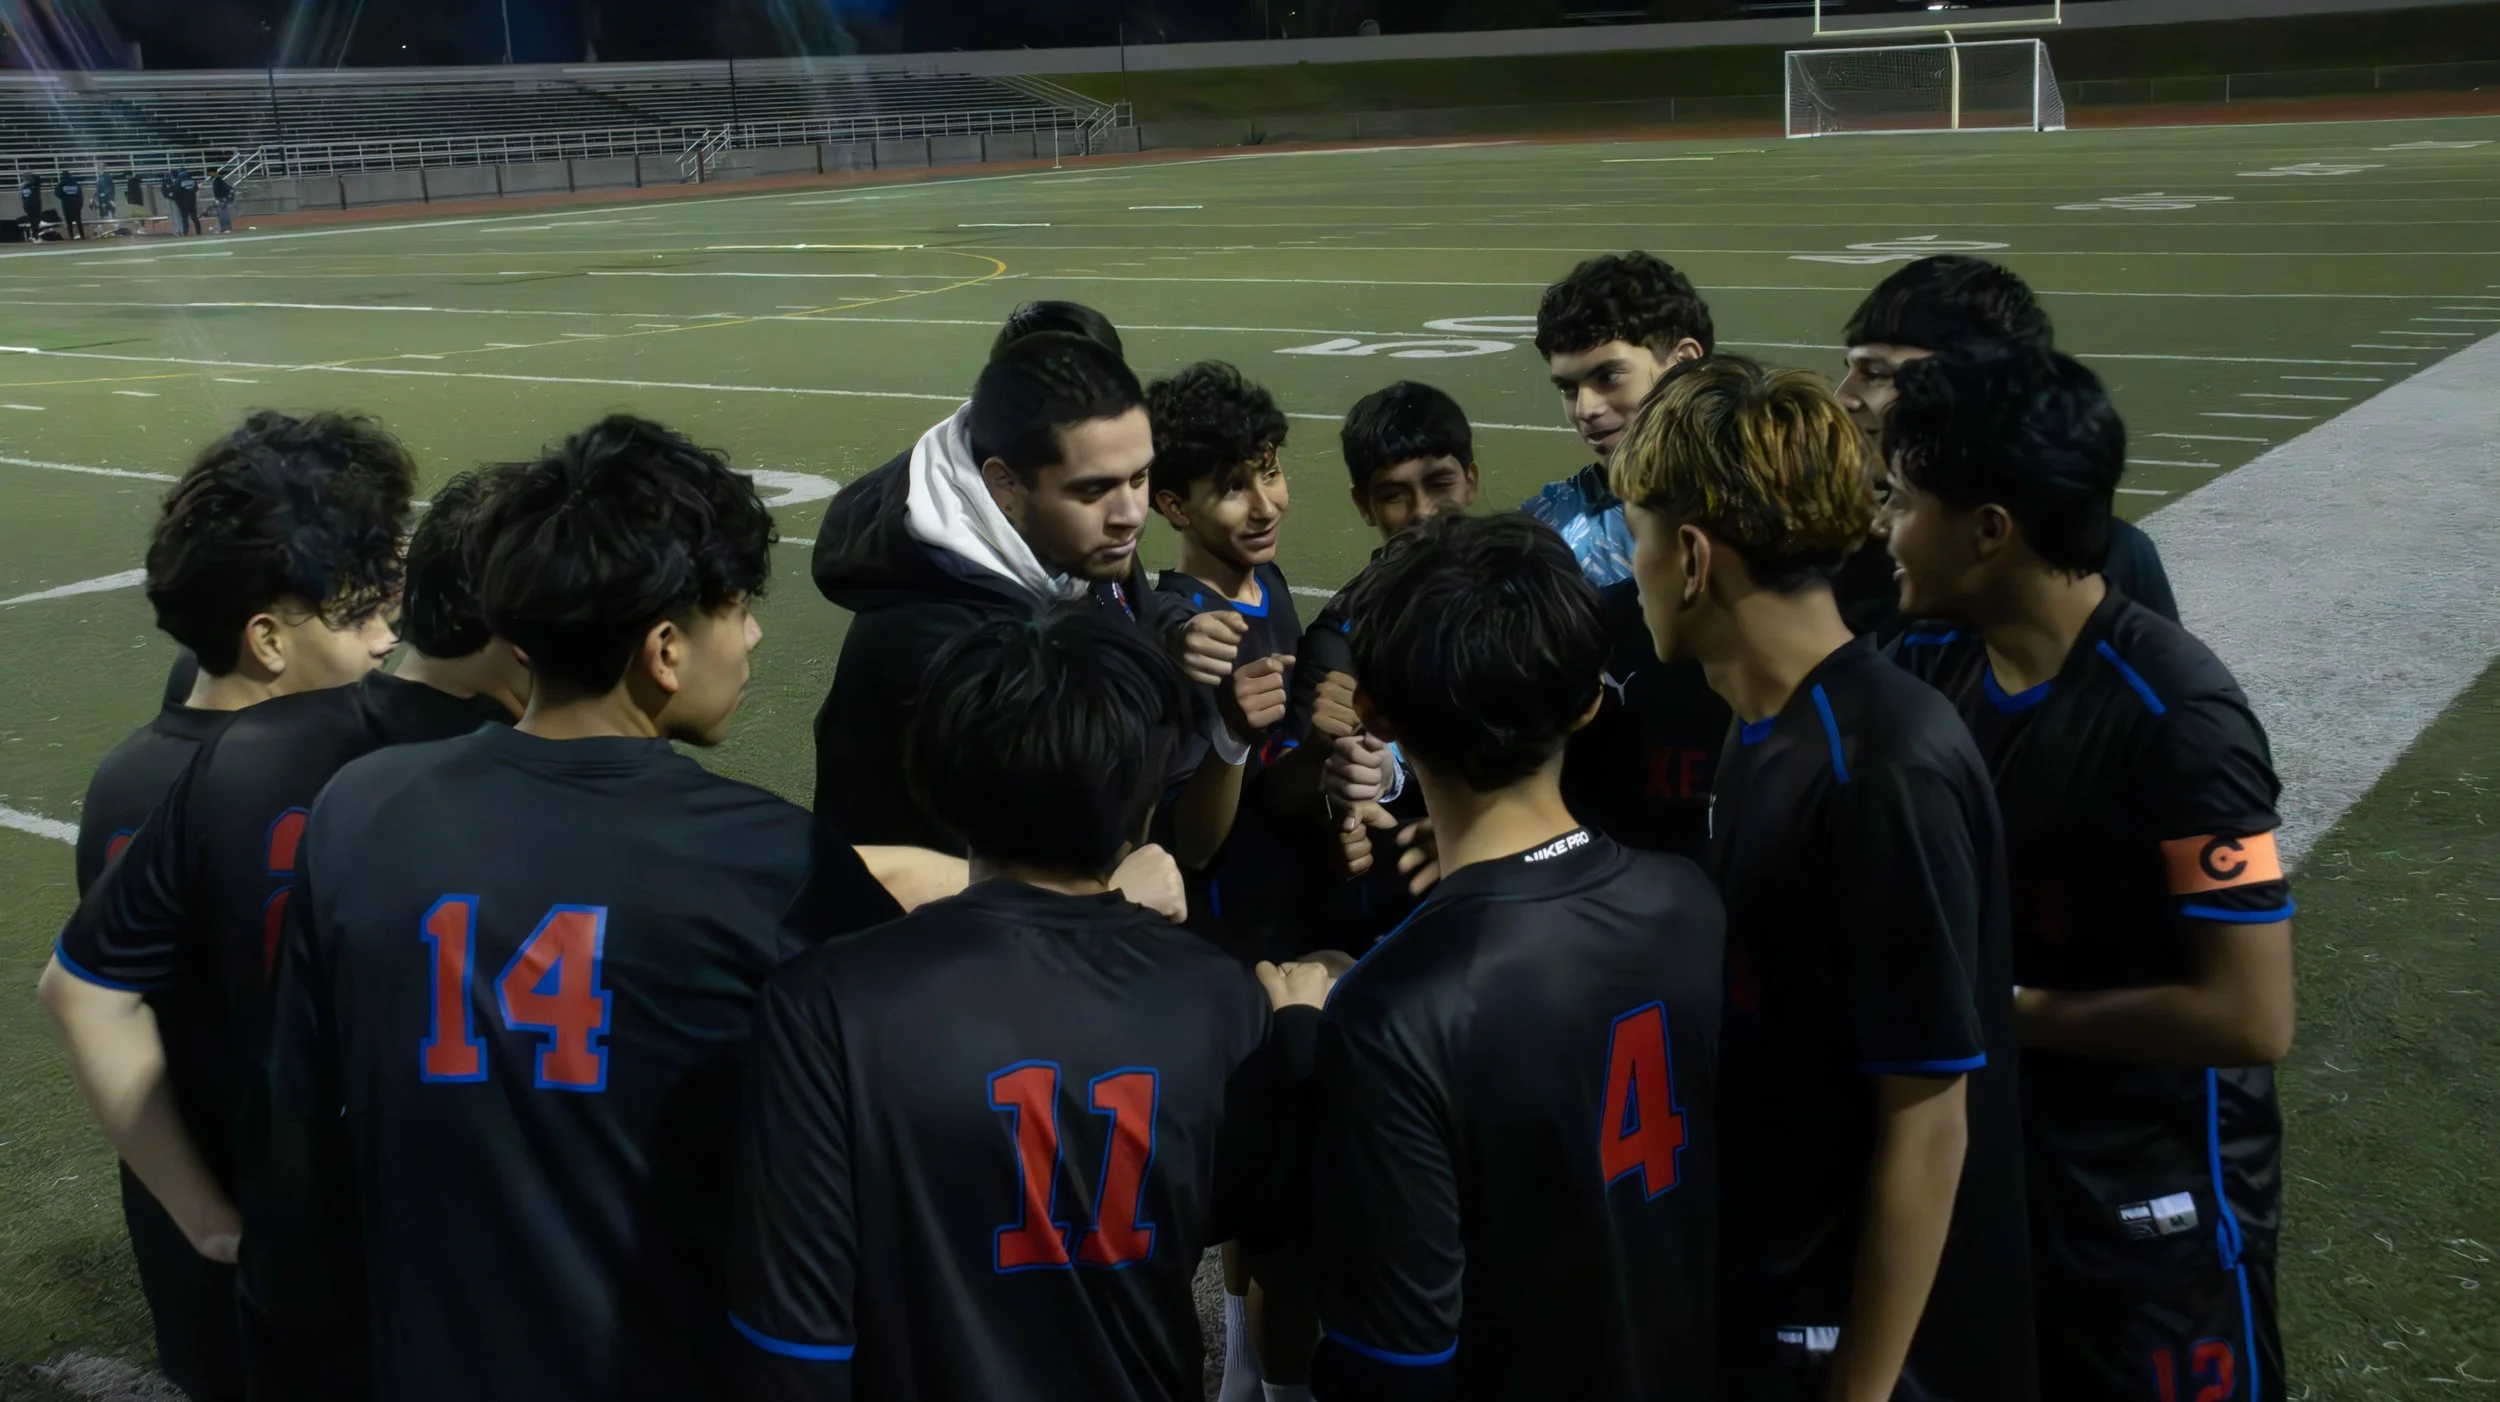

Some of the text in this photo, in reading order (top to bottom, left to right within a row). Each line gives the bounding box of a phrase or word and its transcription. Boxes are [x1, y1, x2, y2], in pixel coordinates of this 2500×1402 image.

[1566, 831, 1590, 850] PRO
[2200, 837, 2248, 881] C
[419, 893, 613, 1094] 14
[987, 1059, 1160, 1274] 11
[1598, 1000, 1689, 1202] 4
